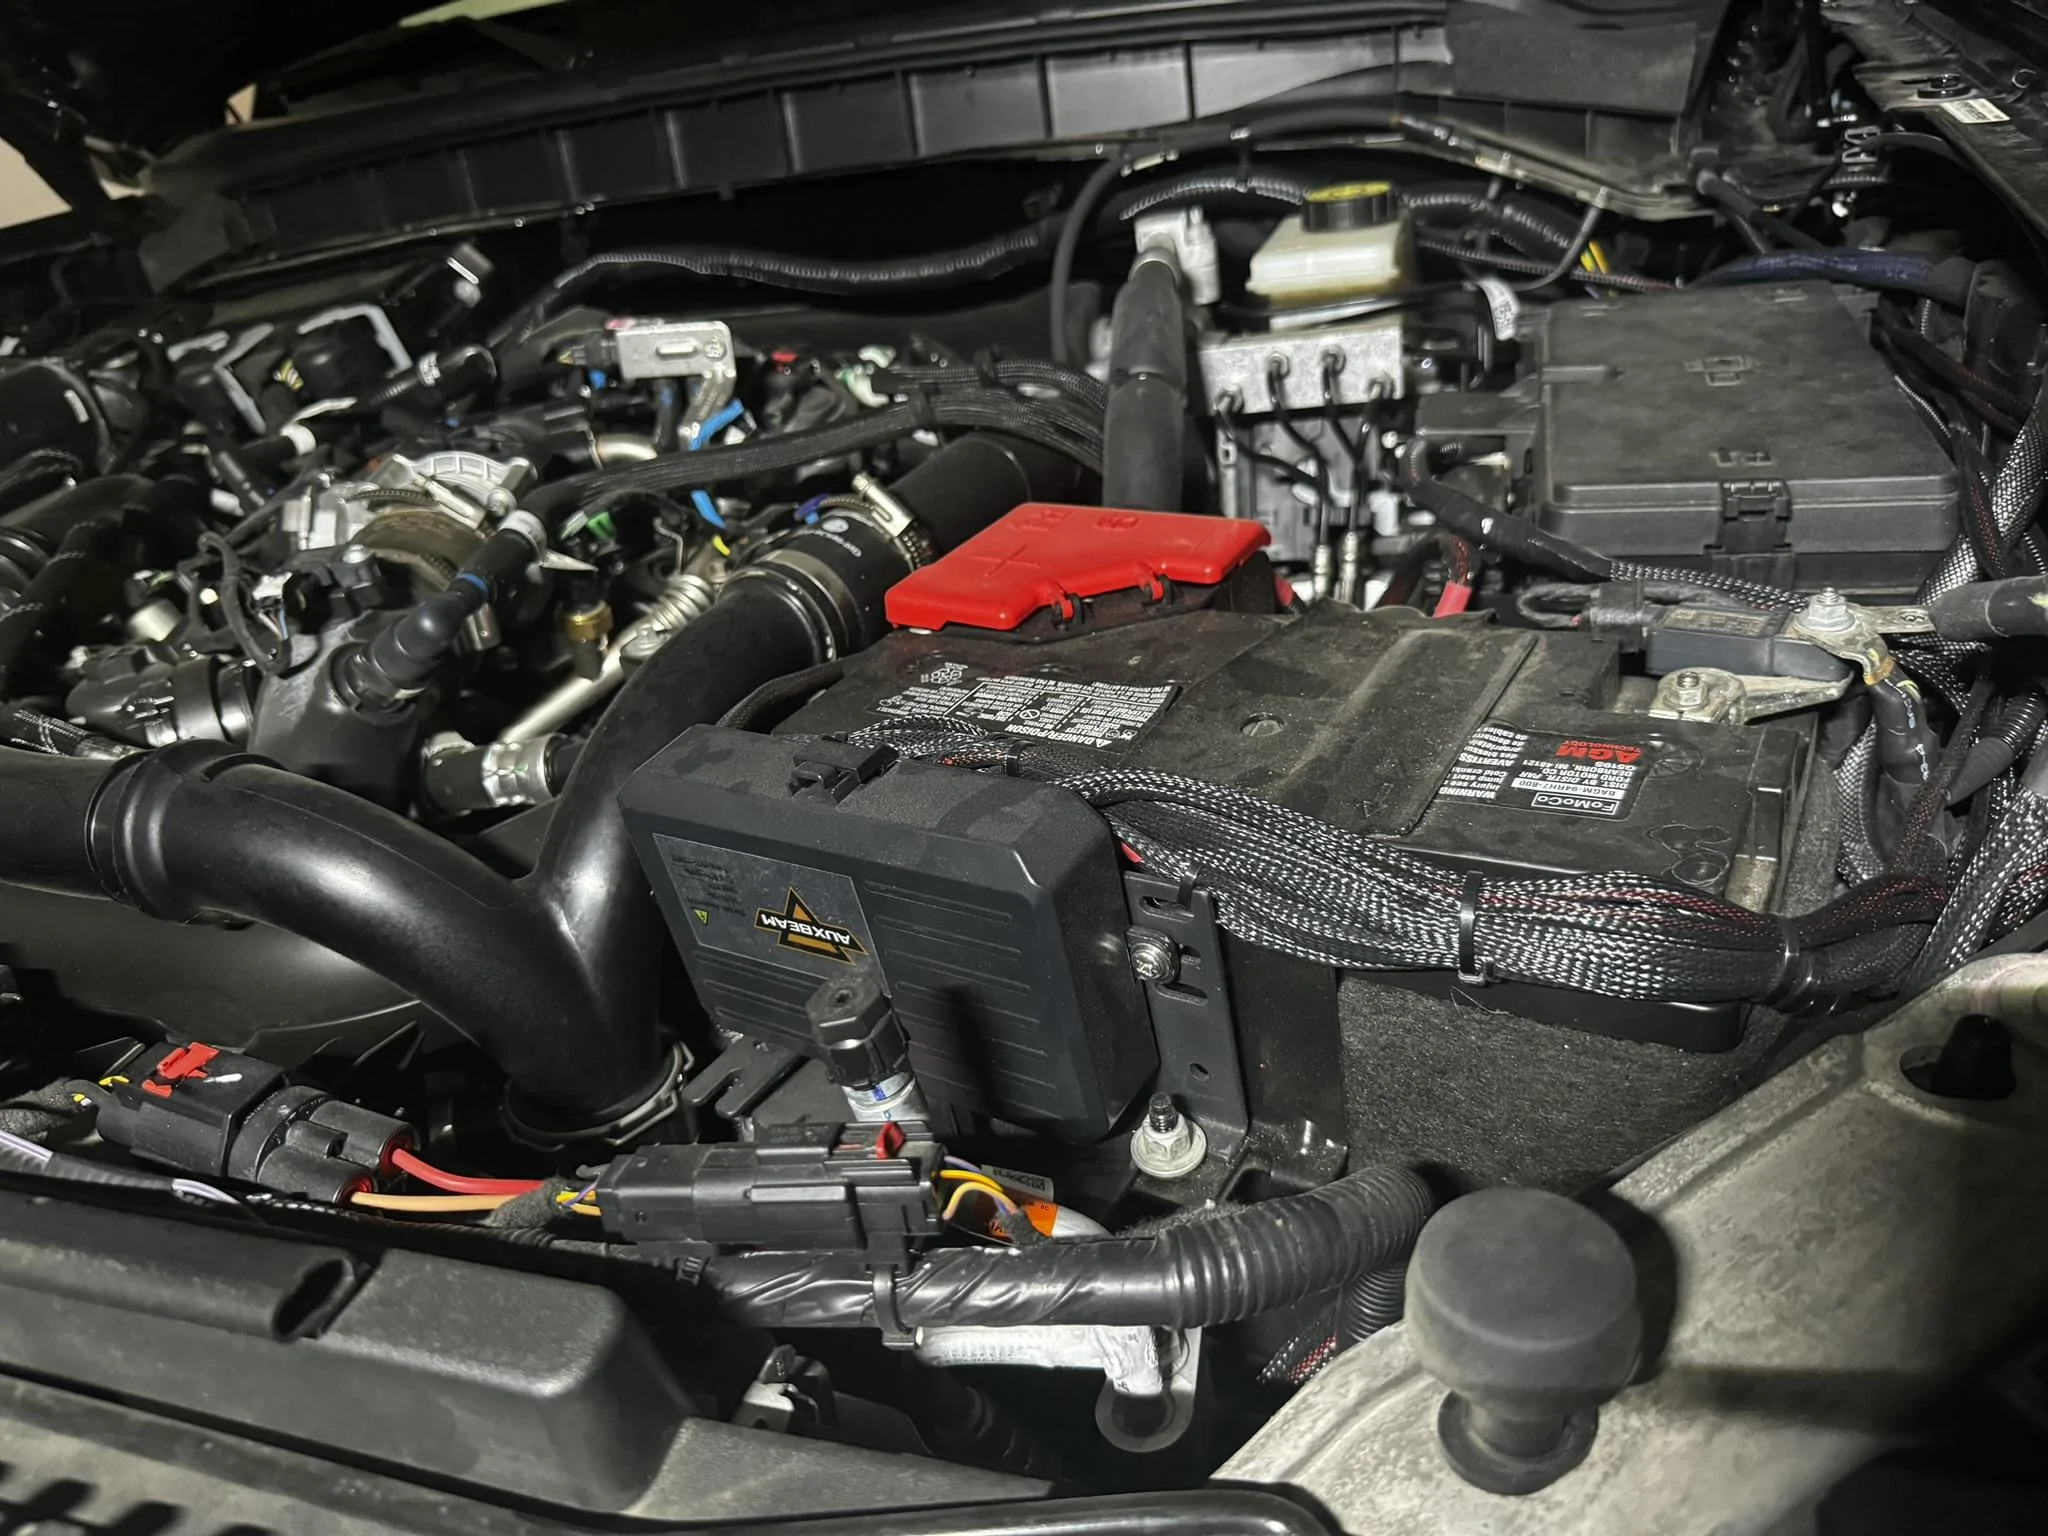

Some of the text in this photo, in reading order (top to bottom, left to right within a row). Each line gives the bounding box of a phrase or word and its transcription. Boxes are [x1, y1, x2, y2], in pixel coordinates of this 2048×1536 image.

[1005, 724, 1096, 745] DANGER/POISON
[1483, 727, 1515, 738] cables
[1562, 740, 1641, 752] TECHNOLOGY
[1555, 745, 1641, 763] AGM
[1522, 760, 1553, 768] 48121
[1518, 771, 1544, 779] PAR
[1558, 770, 1598, 779] MOTOR
[1572, 764, 1633, 777] DEARBORN,
[1477, 775, 1504, 784] jump
[1546, 774, 1581, 784] DISTR.
[1601, 774, 1630, 782] FORD
[1601, 780, 1628, 789] DIST.
[1438, 787, 1496, 799] WARNING
[1537, 795, 1615, 811] FoMoCo
[761, 914, 850, 944] AUXBEAM
